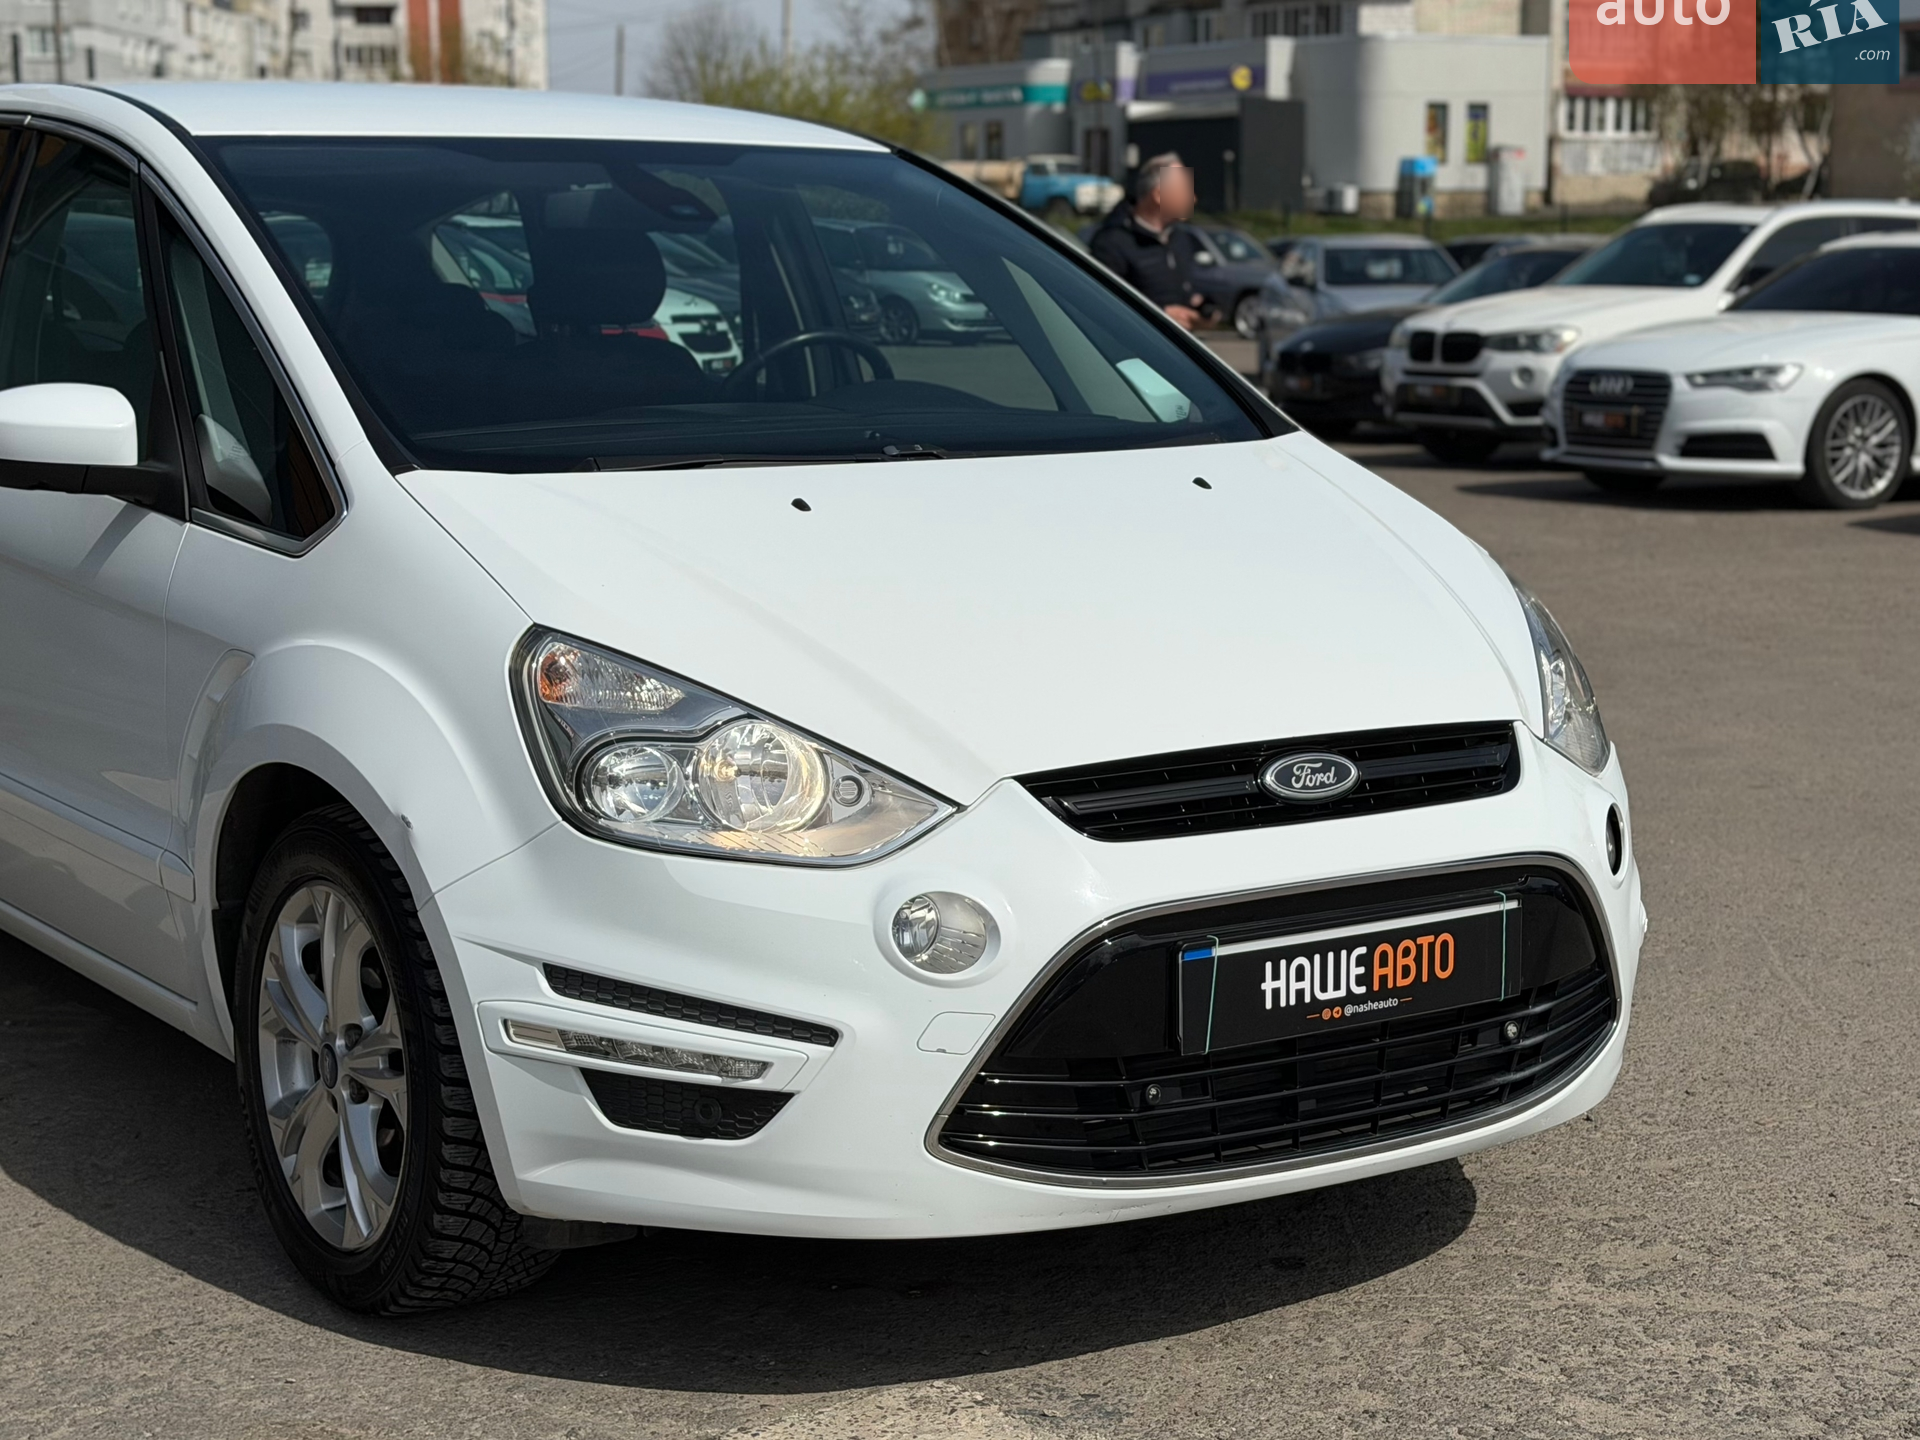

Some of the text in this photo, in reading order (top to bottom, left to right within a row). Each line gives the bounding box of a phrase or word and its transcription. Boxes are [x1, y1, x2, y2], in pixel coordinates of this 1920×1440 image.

[1291, 762, 1337, 788] Ford
[1261, 932, 1455, 1010] НАШЕ АВТО
[1344, 997, 1398, 1017] @nasheauto
